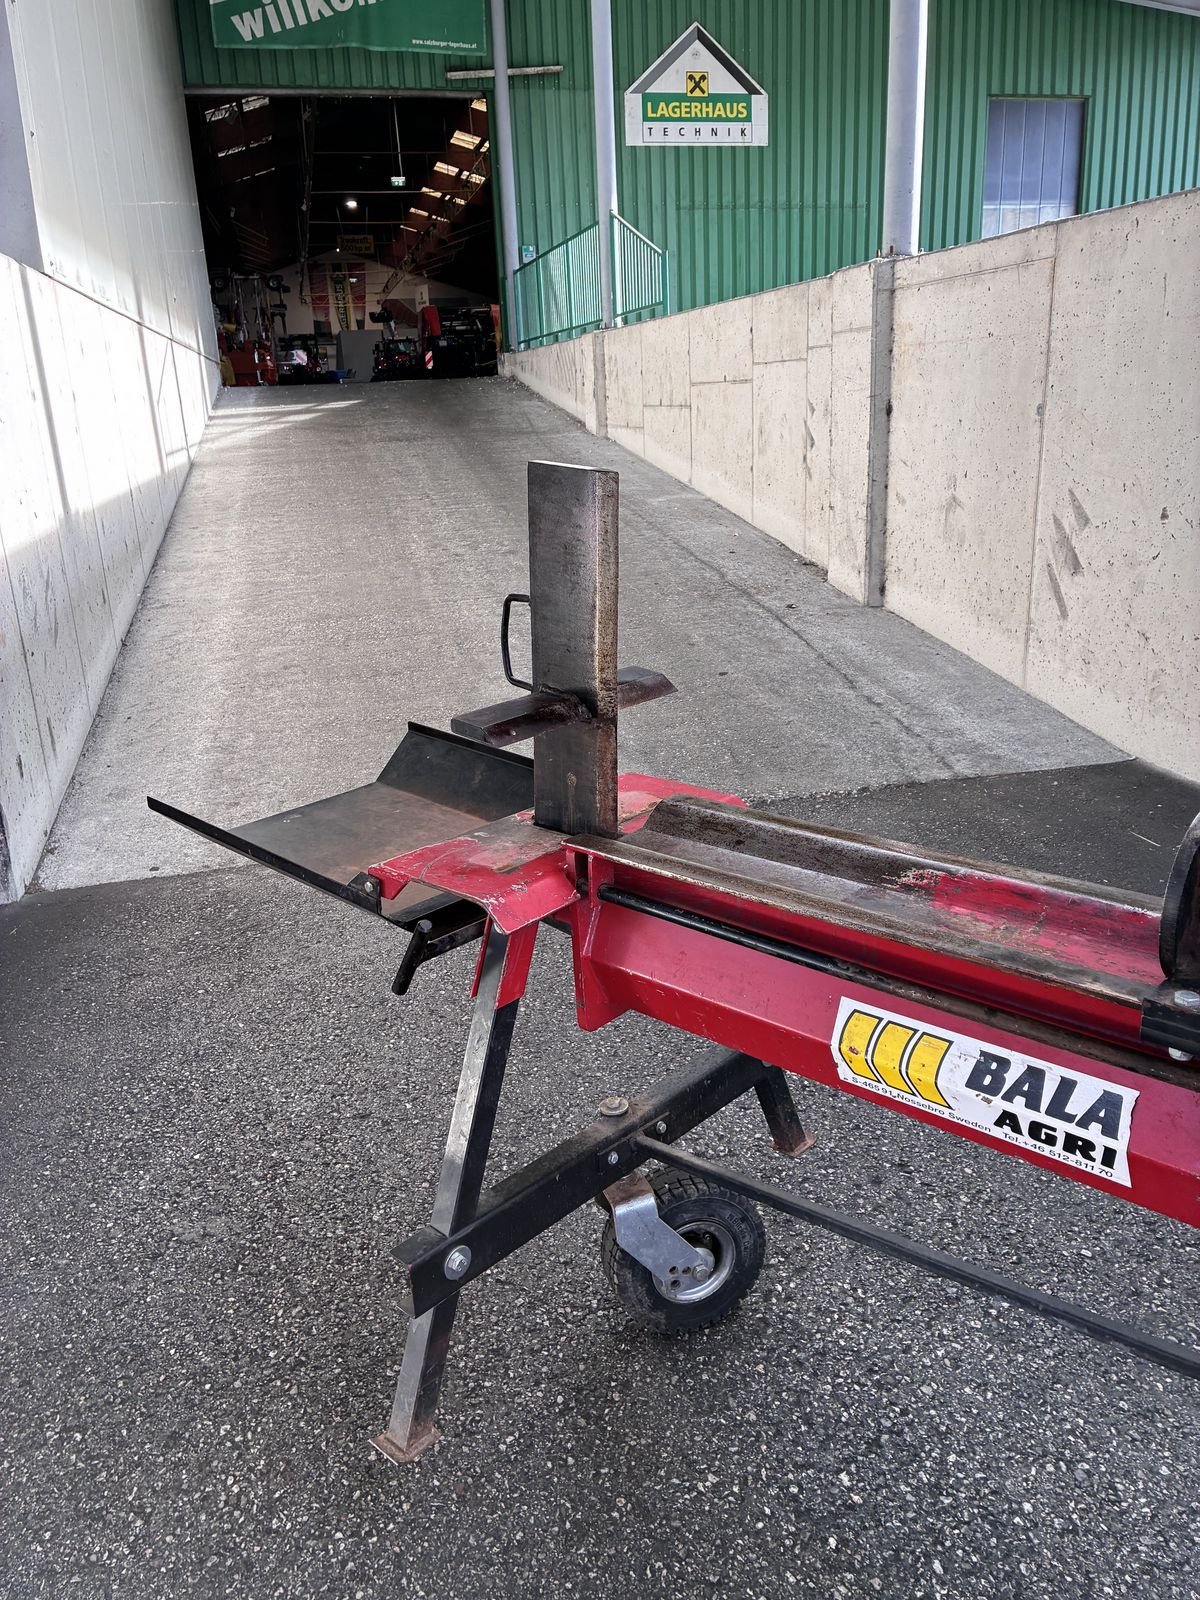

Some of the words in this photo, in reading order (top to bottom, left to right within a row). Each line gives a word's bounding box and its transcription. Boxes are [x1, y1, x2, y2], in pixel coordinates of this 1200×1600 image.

[646, 101, 748, 119] LAGERHAUS
[647, 127, 747, 137] TECHNIK
[335, 284, 348, 331] AGERHAUS
[896, 1093, 945, 1116] Nossebro
[948, 1112, 992, 1133] Sweden
[964, 1049, 1125, 1141] BALA
[993, 1109, 1119, 1170] AGRI
